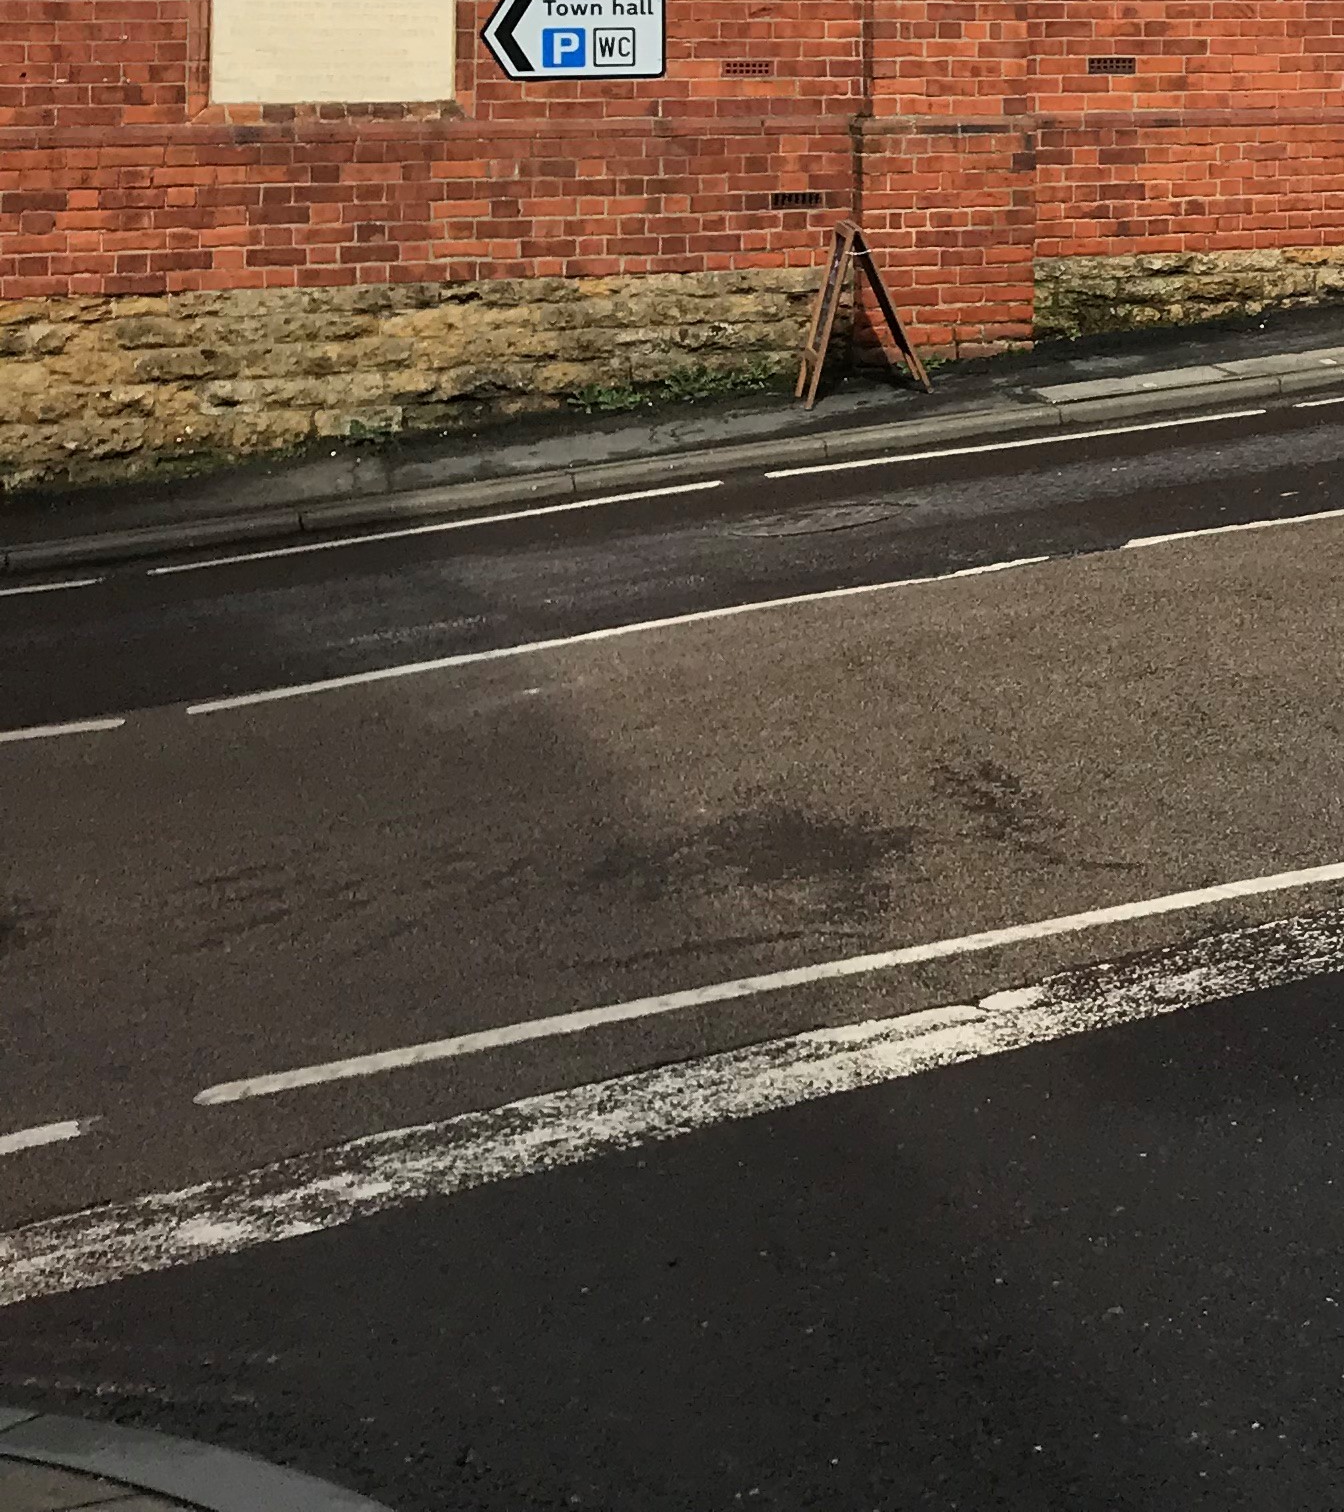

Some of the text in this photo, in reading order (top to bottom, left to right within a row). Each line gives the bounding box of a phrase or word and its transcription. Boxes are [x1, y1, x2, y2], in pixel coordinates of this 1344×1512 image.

[543, 0, 654, 16] Town hall
[552, 32, 632, 65] P WC
